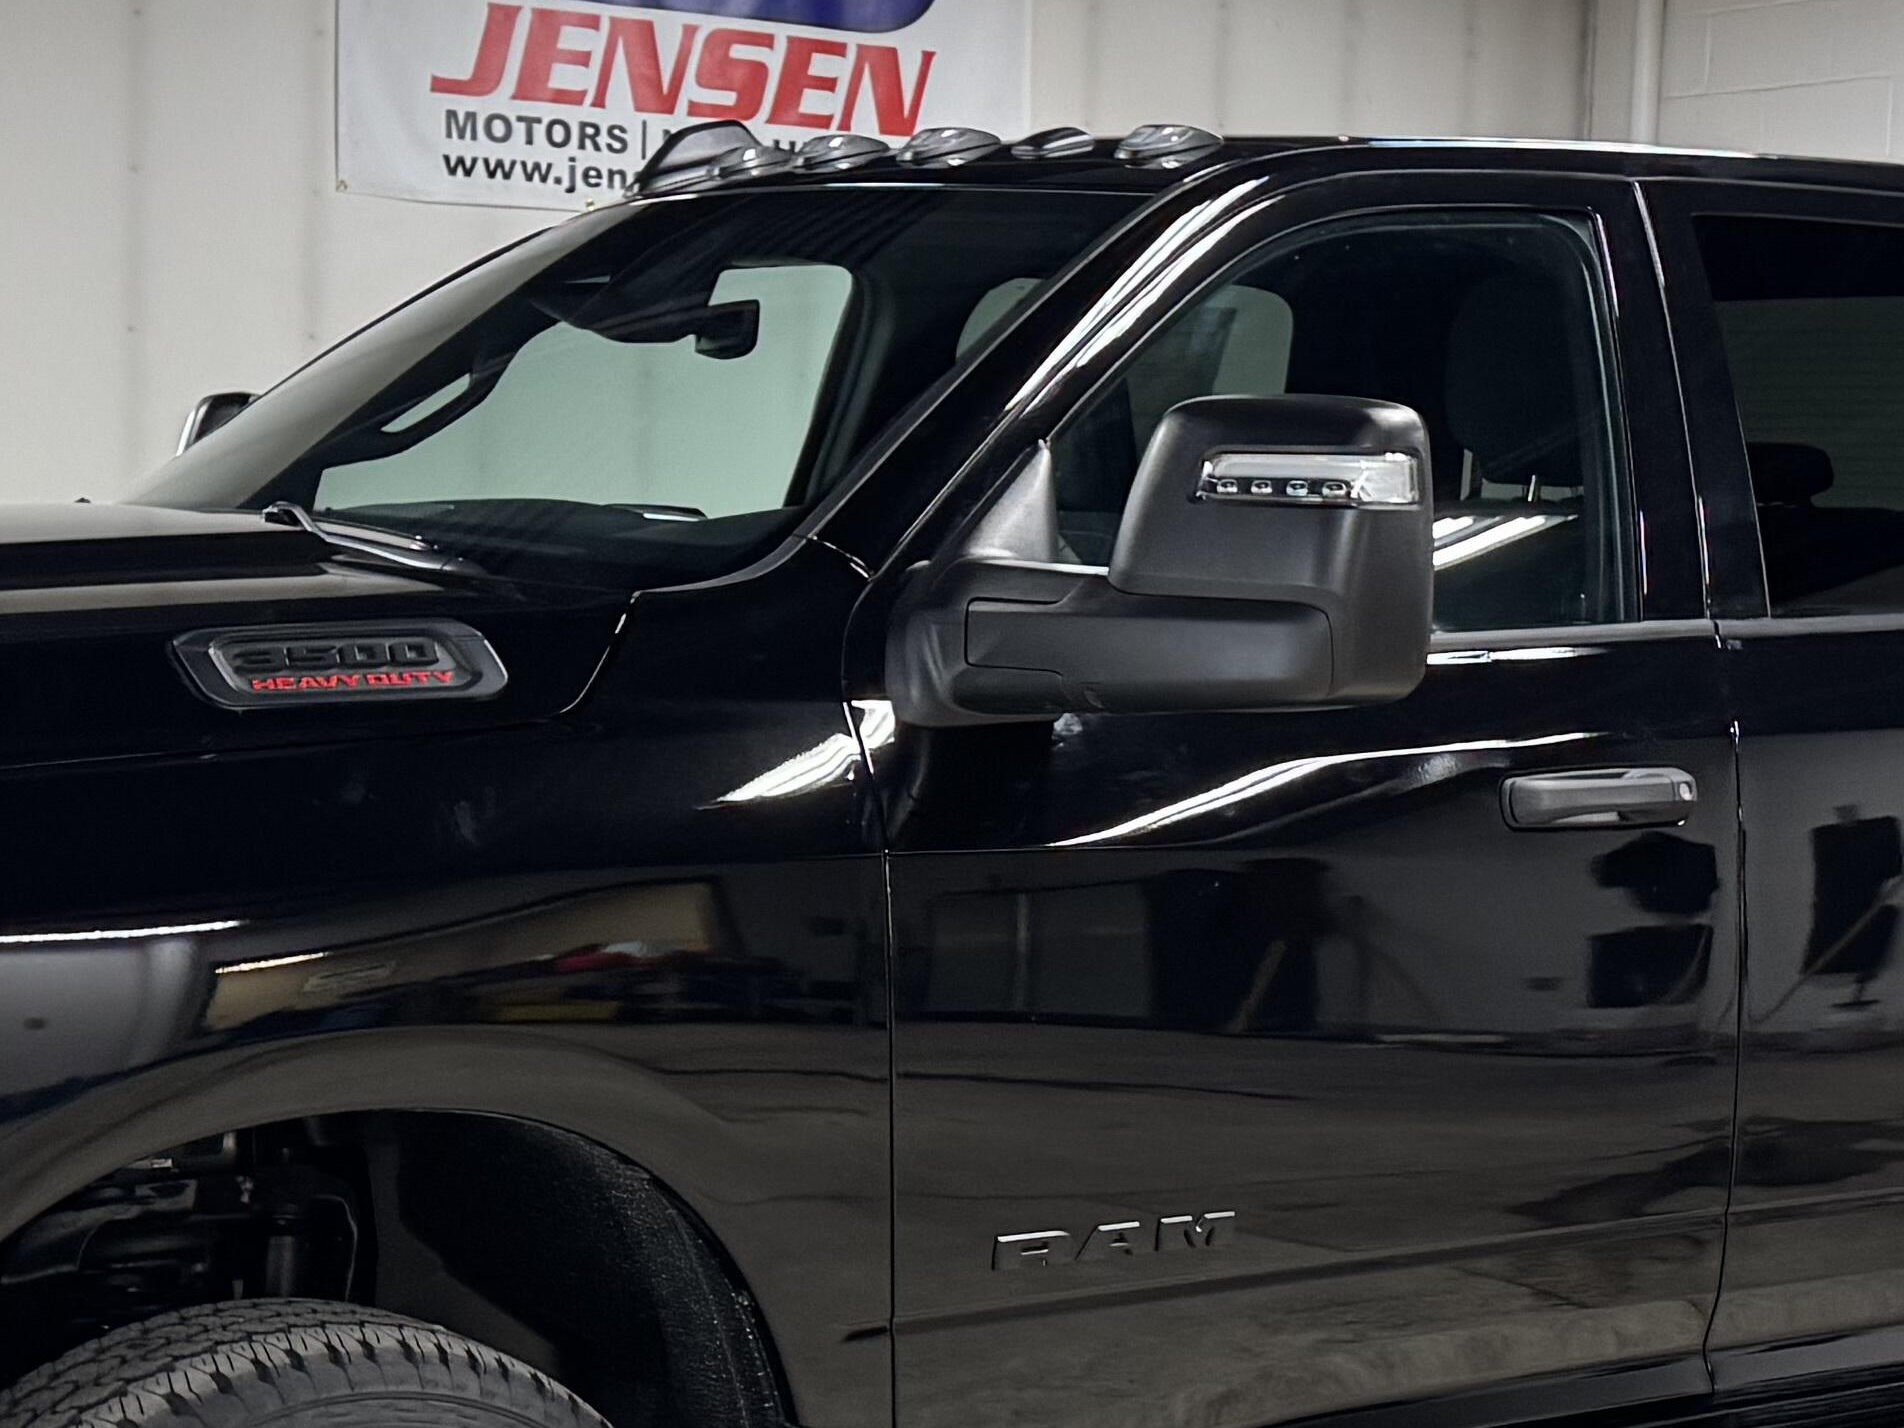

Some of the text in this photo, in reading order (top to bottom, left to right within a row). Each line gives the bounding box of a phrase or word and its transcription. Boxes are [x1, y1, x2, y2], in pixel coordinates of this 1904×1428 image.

[429, 2, 937, 138] JENSEN
[444, 108, 629, 155] MOTORS
[442, 154, 637, 194] www.jen
[250, 670, 454, 693] HEAVY DUTY
[990, 1209, 1237, 1271] RAM
